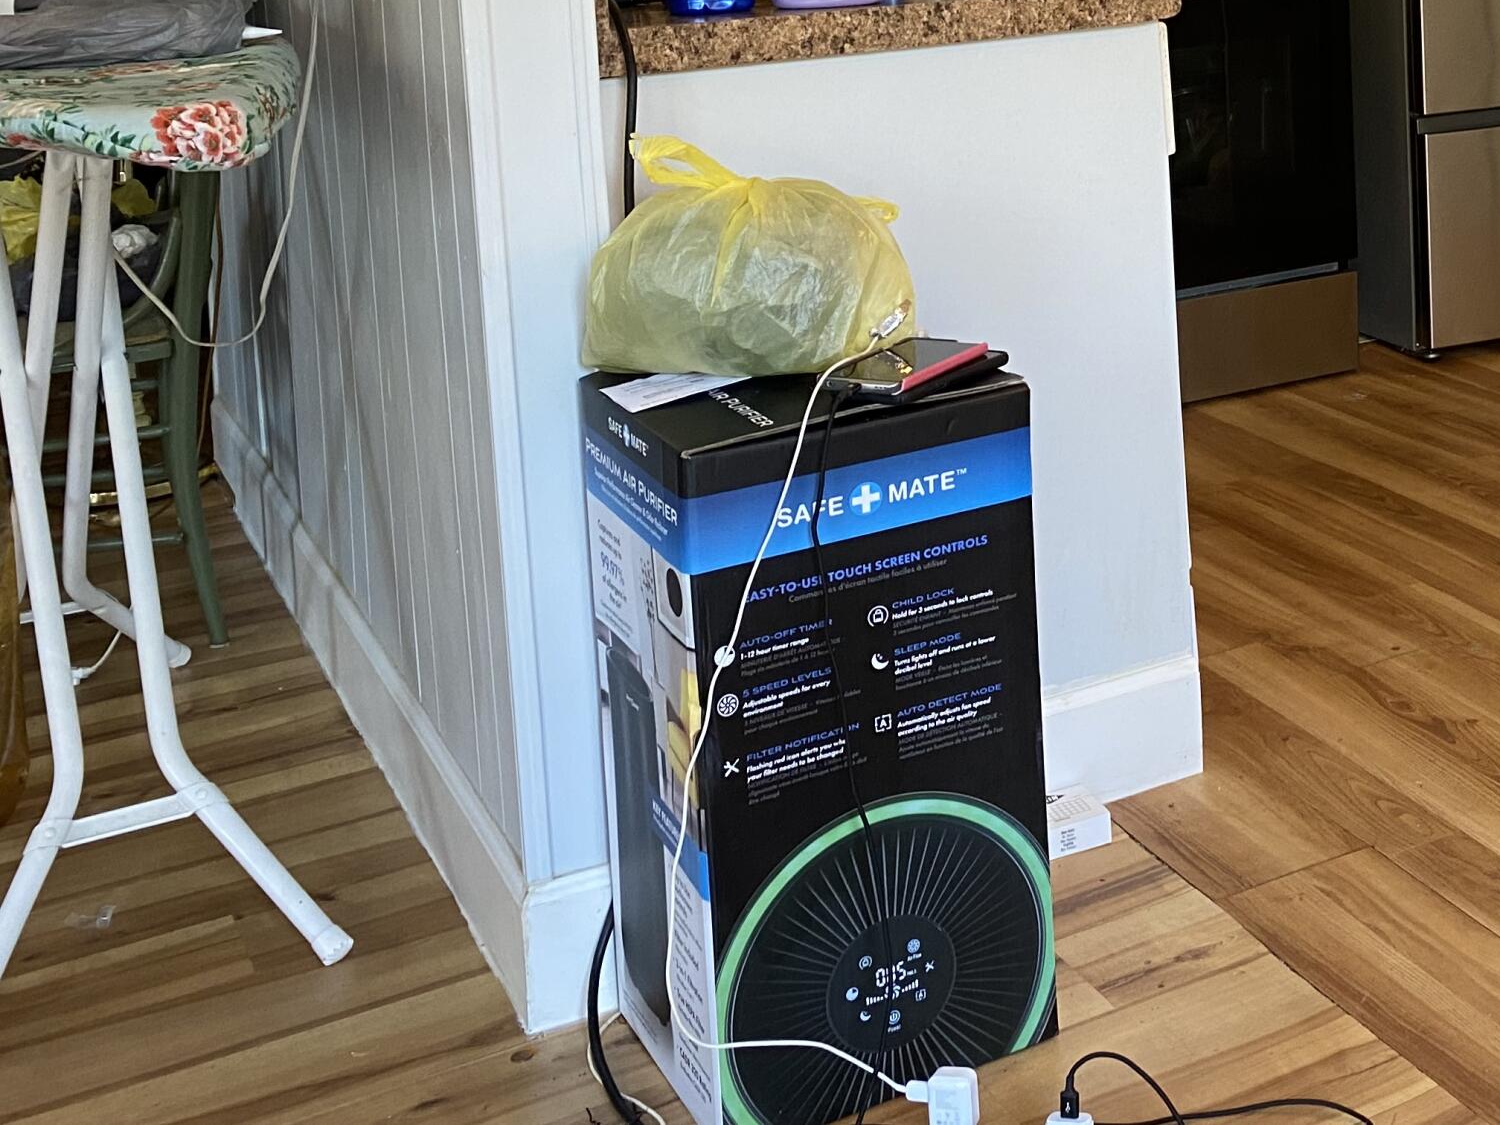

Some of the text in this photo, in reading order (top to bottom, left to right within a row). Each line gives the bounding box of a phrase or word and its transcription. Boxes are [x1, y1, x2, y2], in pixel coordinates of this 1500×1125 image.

[721, 395, 774, 428] PURIFIER
[608, 416, 624, 440] SAFE
[585, 437, 622, 480] PREMIUM
[622, 472, 637, 494] AIR
[638, 481, 678, 526] PURIFIER
[827, 562, 872, 584] TOUCH
[875, 552, 921, 573] SCREEN
[924, 534, 988, 560] CONTROLS
[788, 587, 837, 603] Commanes
[892, 587, 955, 609] CHILD LOCK
[892, 611, 907, 620] Hold
[908, 609, 918, 617] for
[924, 601, 948, 613] seconds
[956, 595, 969, 605] lock
[969, 589, 994, 601] controls
[739, 627, 798, 649] AUTO-OFF
[740, 650, 755, 660] 1-12
[755, 646, 772, 657] hour
[790, 637, 810, 649] range
[894, 632, 962, 656] SLEEP MODE
[894, 657, 911, 667] Turns
[911, 652, 928, 664] lights
[928, 648, 938, 658] off
[938, 646, 951, 655] and
[978, 635, 996, 646] lower
[742, 667, 832, 698] 5 SPEED LEVELS
[894, 659, 933, 676] decibel level
[742, 694, 777, 709] Adjustable
[778, 688, 801, 700] speeds
[811, 680, 831, 691] every
[743, 701, 784, 718] environment
[897, 683, 1002, 718] AUTO DETECT MODE
[897, 696, 992, 728] Automatically adjusts fan speed
[897, 723, 928, 737] according
[935, 718, 946, 727] the
[956, 710, 978, 722] quality
[746, 723, 860, 762] FILTER NOTIFICATIN
[746, 760, 773, 773] Flashing
[773, 755, 786, 765] red
[786, 752, 800, 761] icon
[800, 746, 819, 757] alerts
[819, 743, 832, 754] you
[747, 772, 763, 784] your
[763, 767, 778, 777] filter
[779, 763, 798, 773] needs
[816, 747, 844, 762] changed
